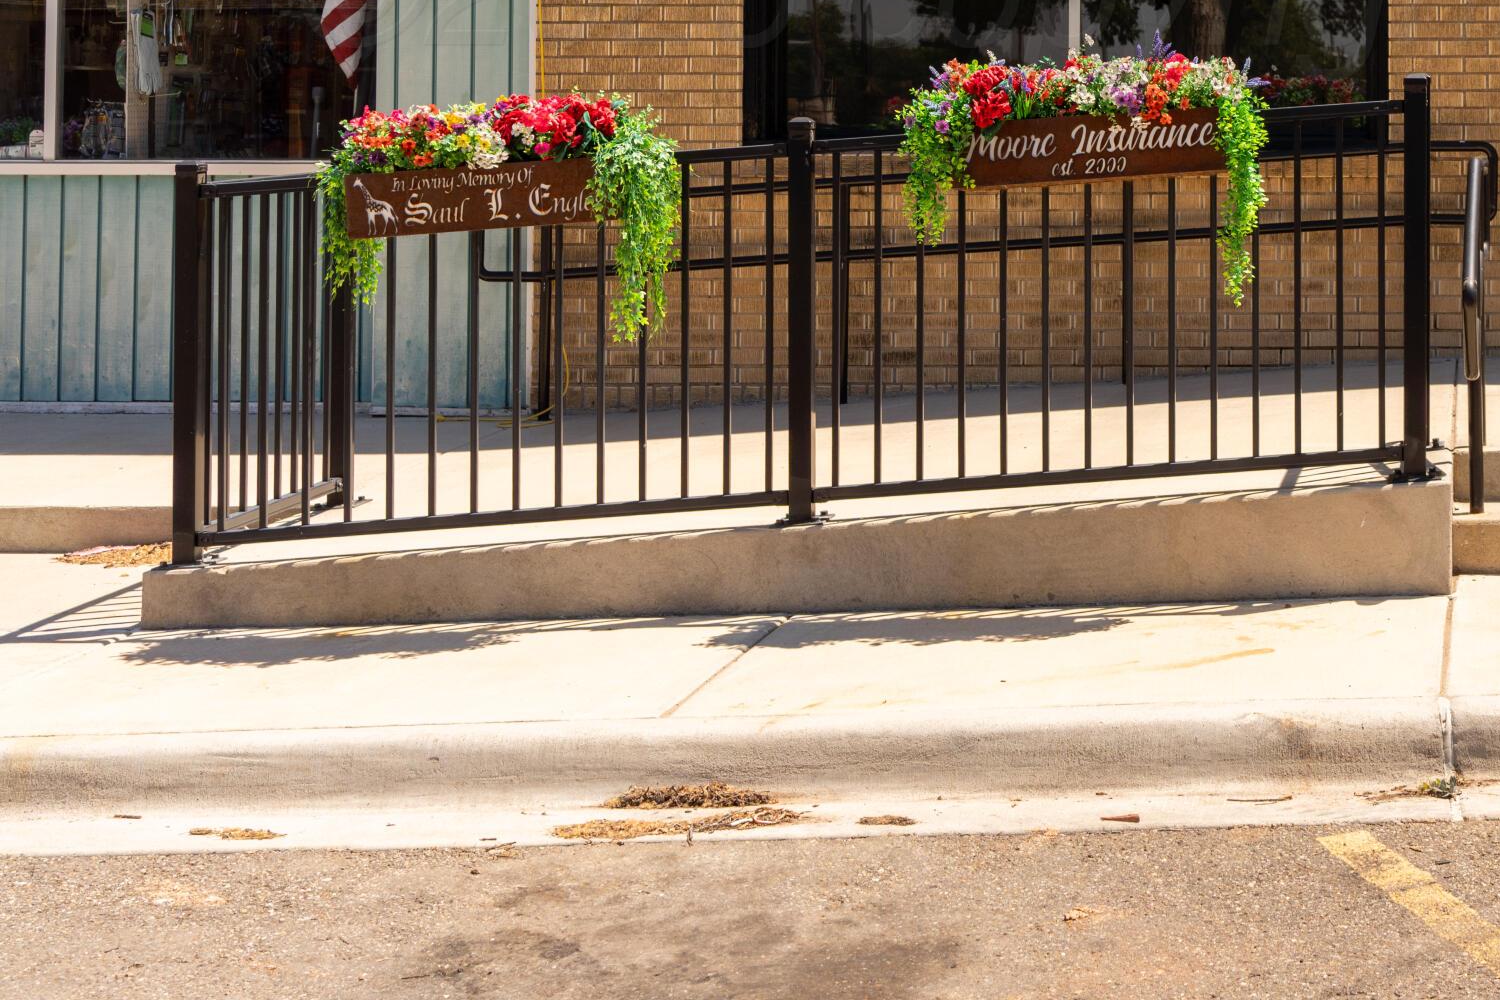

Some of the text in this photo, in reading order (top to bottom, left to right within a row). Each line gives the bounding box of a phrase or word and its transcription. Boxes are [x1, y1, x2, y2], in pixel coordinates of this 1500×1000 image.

[966, 121, 1215, 163] Moore Insurance
[392, 165, 535, 194] In Loving Memory Of
[404, 192, 471, 226] Saul
